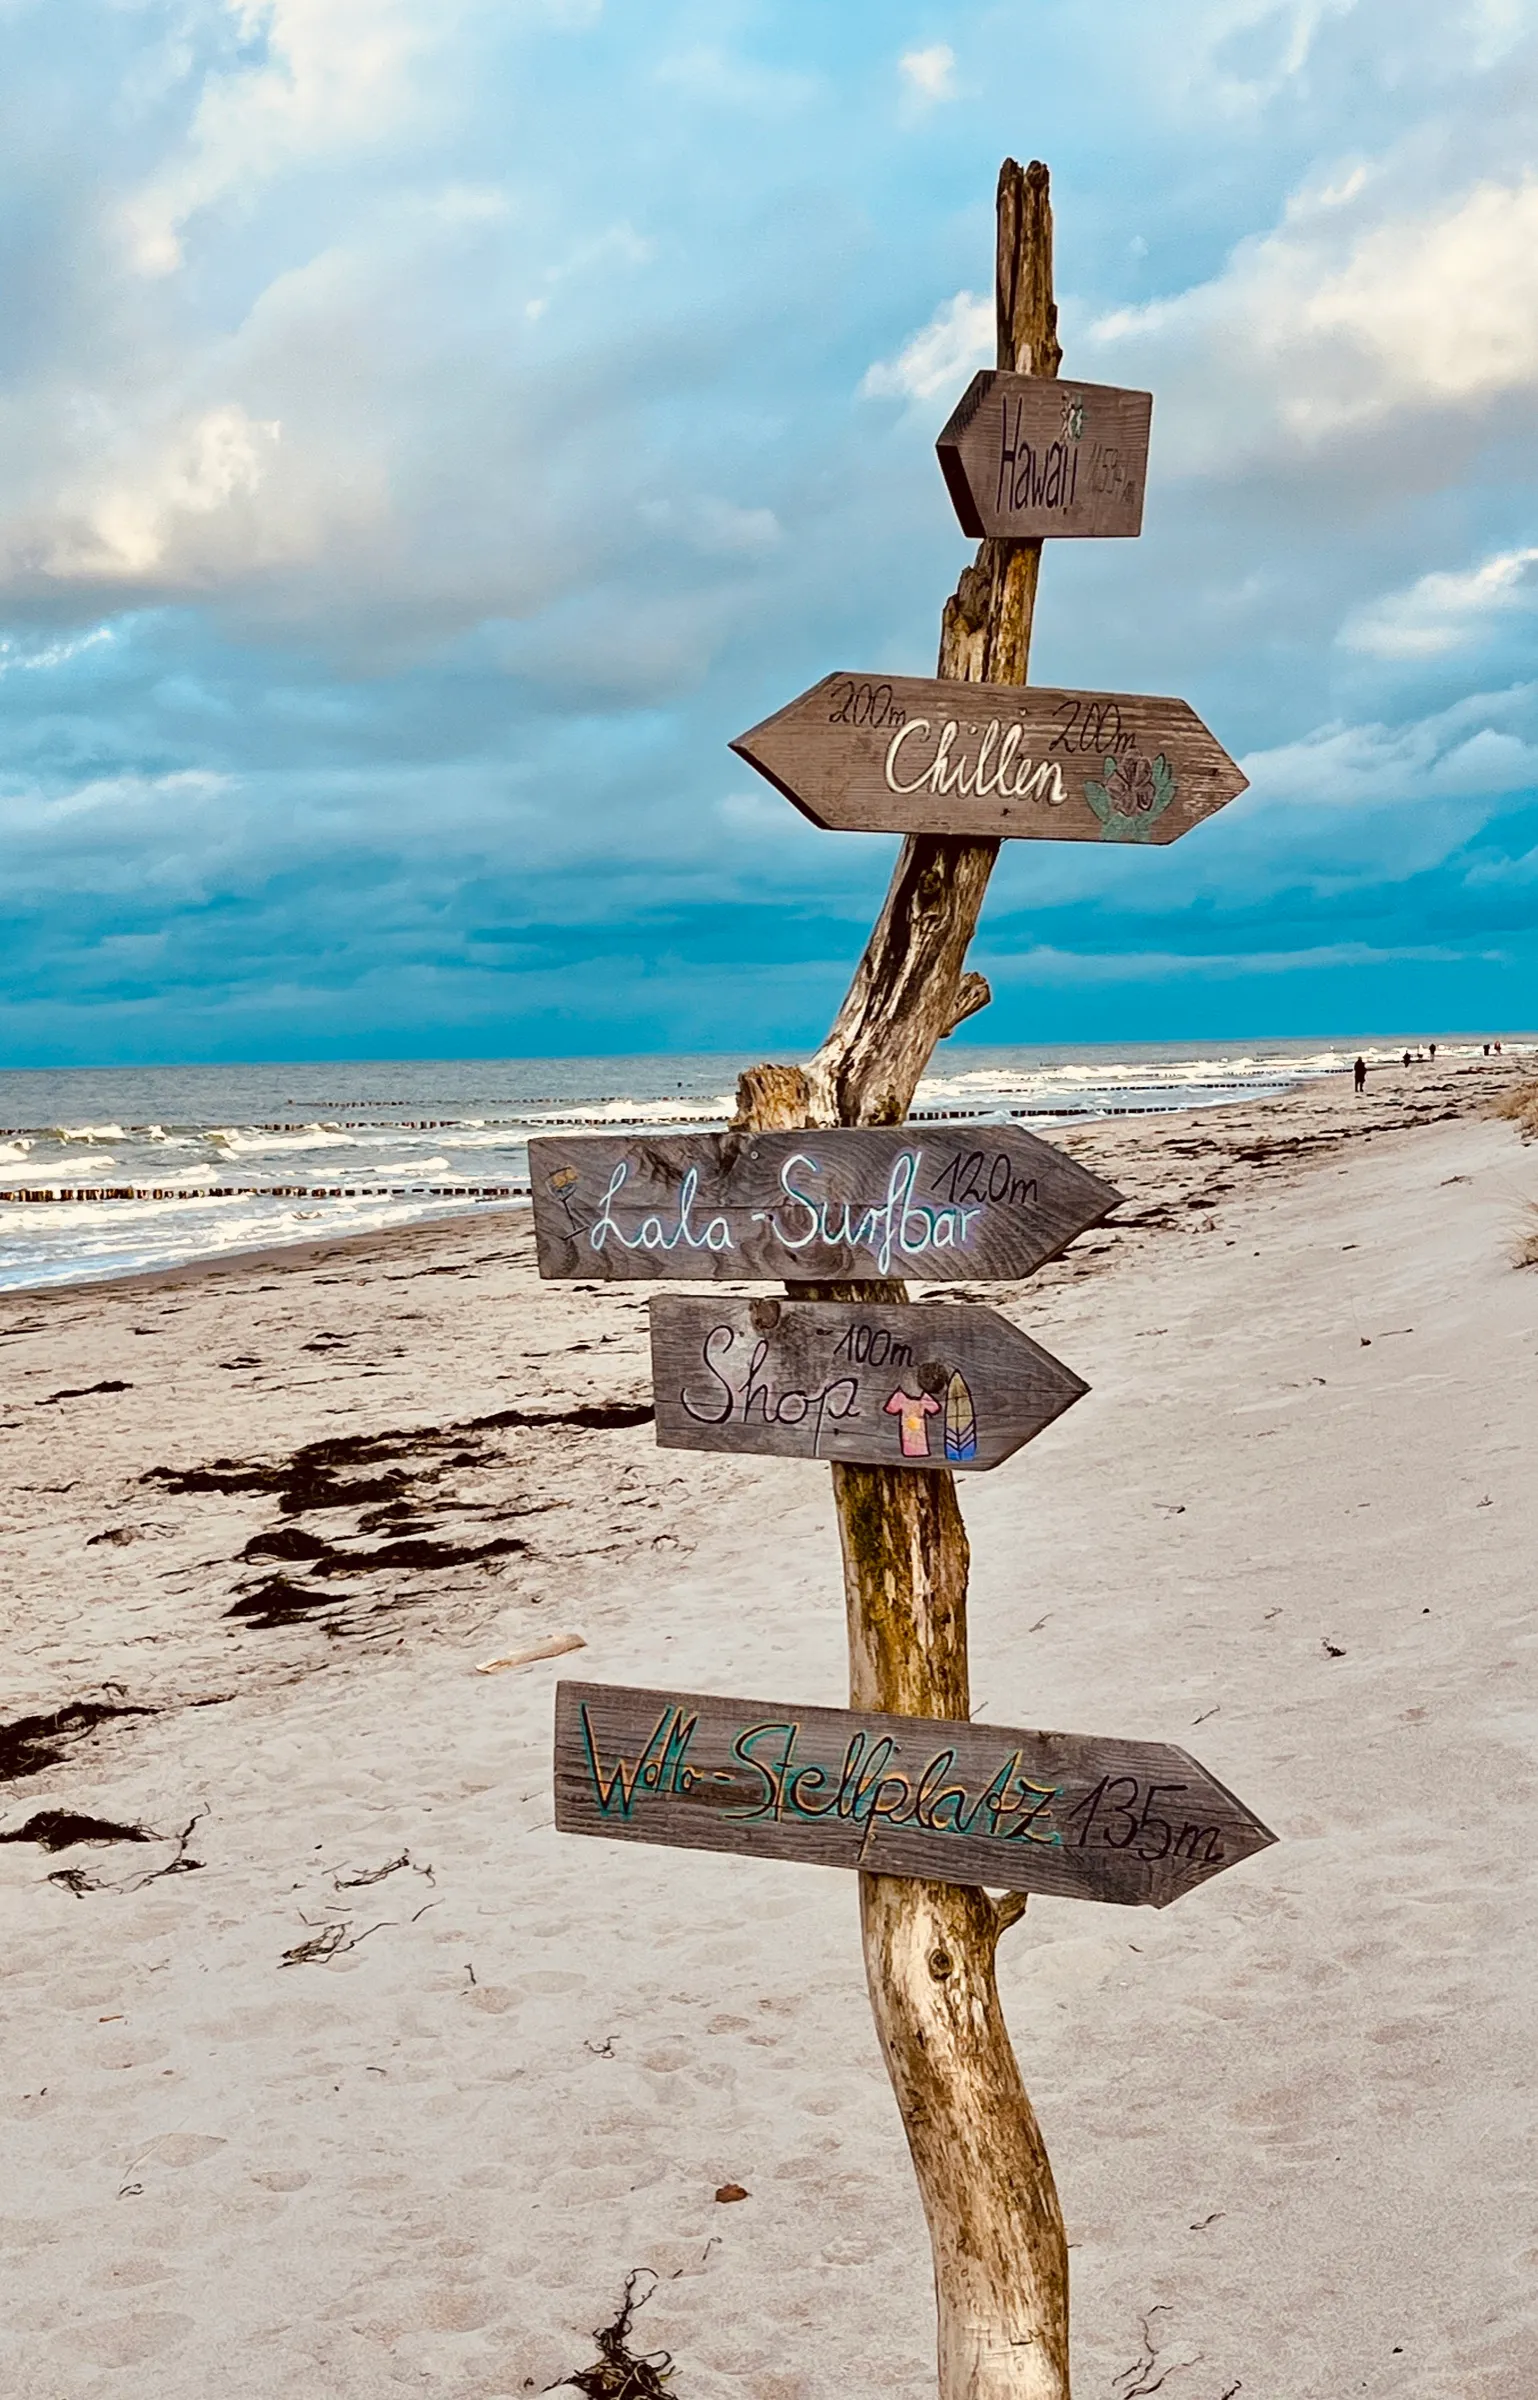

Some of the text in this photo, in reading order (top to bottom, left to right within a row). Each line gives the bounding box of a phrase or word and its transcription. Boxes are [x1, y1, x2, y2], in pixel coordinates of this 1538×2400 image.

[829, 683, 1138, 805] 200m Chillen 200m
[590, 1161, 735, 1250] Lala
[931, 1151, 1038, 1204] 120m
[681, 1323, 916, 1456] Shop 100m
[1070, 1774, 1225, 1863] 135m
